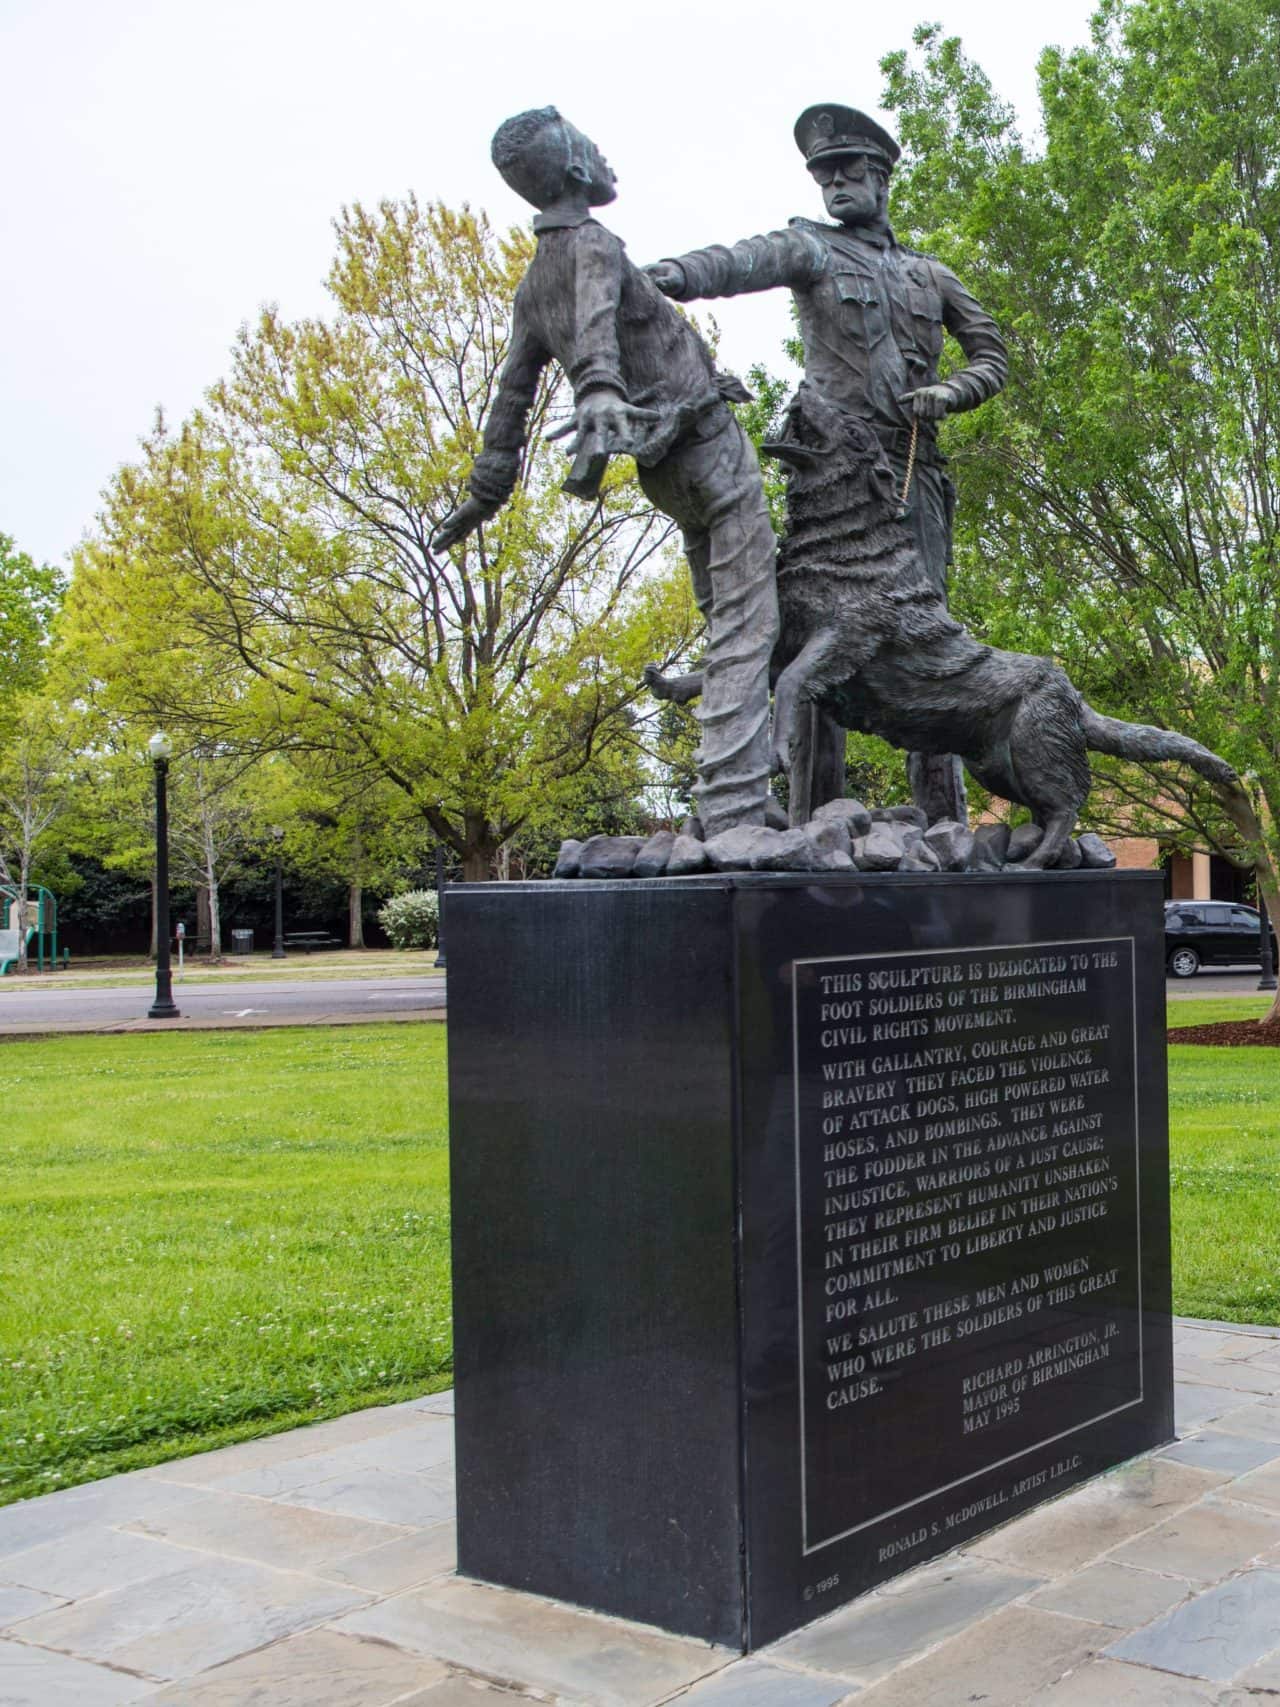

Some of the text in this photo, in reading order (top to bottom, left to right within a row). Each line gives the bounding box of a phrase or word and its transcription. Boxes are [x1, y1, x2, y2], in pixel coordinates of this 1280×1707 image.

[820, 951, 1117, 995] THIS SCULPTURE IS DEDICATED TO THE
[821, 977, 1085, 1021] FOOT SOLDIERS OF THE BIRMINGHAM
[820, 1007, 1015, 1048] CIVIL RIGHTS MOVEMENT.
[822, 1024, 1109, 1082] WITH GALLANTRY, COURAGE AND GREAT
[822, 1048, 1091, 1108] BRAVERY THEY FACED THE VIOLENCE
[822, 1068, 1109, 1136] OF ATTACK DOGS, HIGH POWERED WATER
[824, 1094, 1084, 1163] HOSES, AND BOMBINGS. THEY WERE
[824, 1112, 1103, 1188] THE FODDER IN THE ADVANCE AGAINST
[824, 1134, 1103, 1217] INJUSTICE, WARRIORS OF A JUST CAUSE;
[824, 1155, 1109, 1242] THEY REPRESENT HUMANITY UNSHAKEN
[825, 1175, 1117, 1269] IN THEIR FIRM BELIEF IN THEIR NATION'S
[825, 1199, 1107, 1297] COMMITMENT TO LIBERTY AND JUSTICE
[826, 1284, 897, 1323] FOR ALL.
[826, 1255, 1088, 1357] WE SALUTE THESE MEN AND WOMEN
[827, 1268, 1118, 1384] WHO WERE THE SOLDIERS OF THIS GREAT
[962, 1357, 1022, 1395] RICHARD
[1104, 1320, 1119, 1340] JR.
[963, 1343, 1108, 1415] MAYOR OF BIRMINGHAM
[826, 1374, 883, 1412] CAUSE.
[963, 1397, 1019, 1434] MAY 1995
[816, 1574, 840, 1593] 1995
[878, 1527, 926, 1562] RONALD
[931, 1521, 940, 1537] S.
[1011, 1470, 1047, 1498] ARTIST
